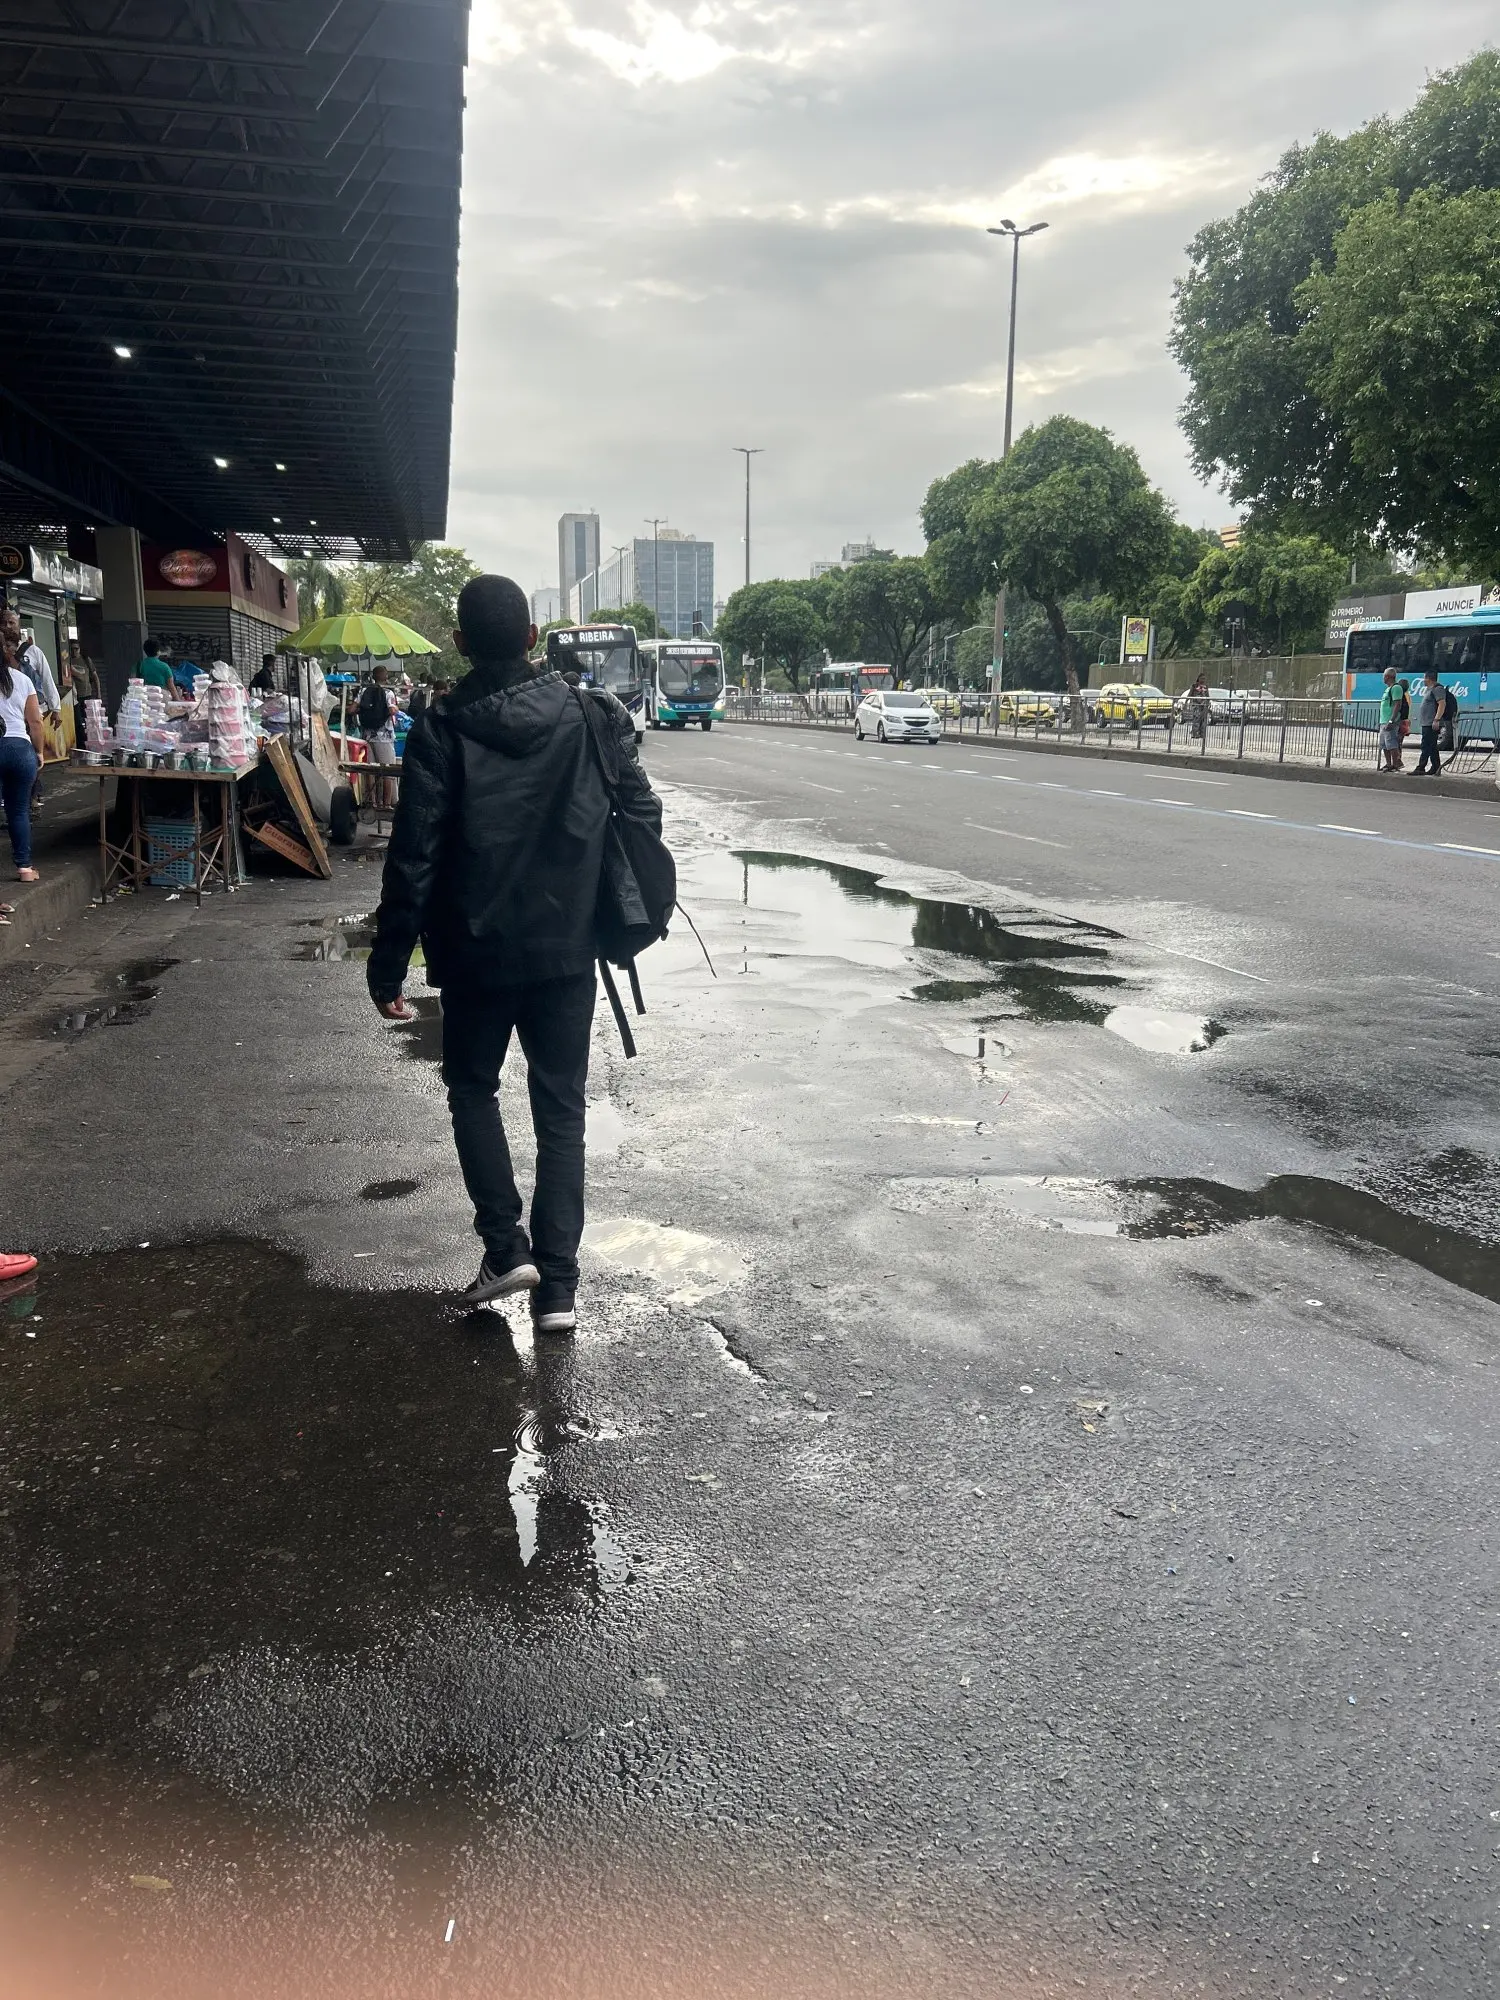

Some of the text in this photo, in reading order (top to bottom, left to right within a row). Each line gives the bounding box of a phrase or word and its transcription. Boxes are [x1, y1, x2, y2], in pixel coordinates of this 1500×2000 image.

[1337, 606, 1364, 617] PRIMEIRO
[1436, 599, 1474, 612] ANUNCIE
[558, 630, 615, 643] 324 RIBEIRA
[1329, 631, 1338, 639] DO
[1408, 677, 1469, 697] Fades
[264, 826, 309, 858] Guaravita
